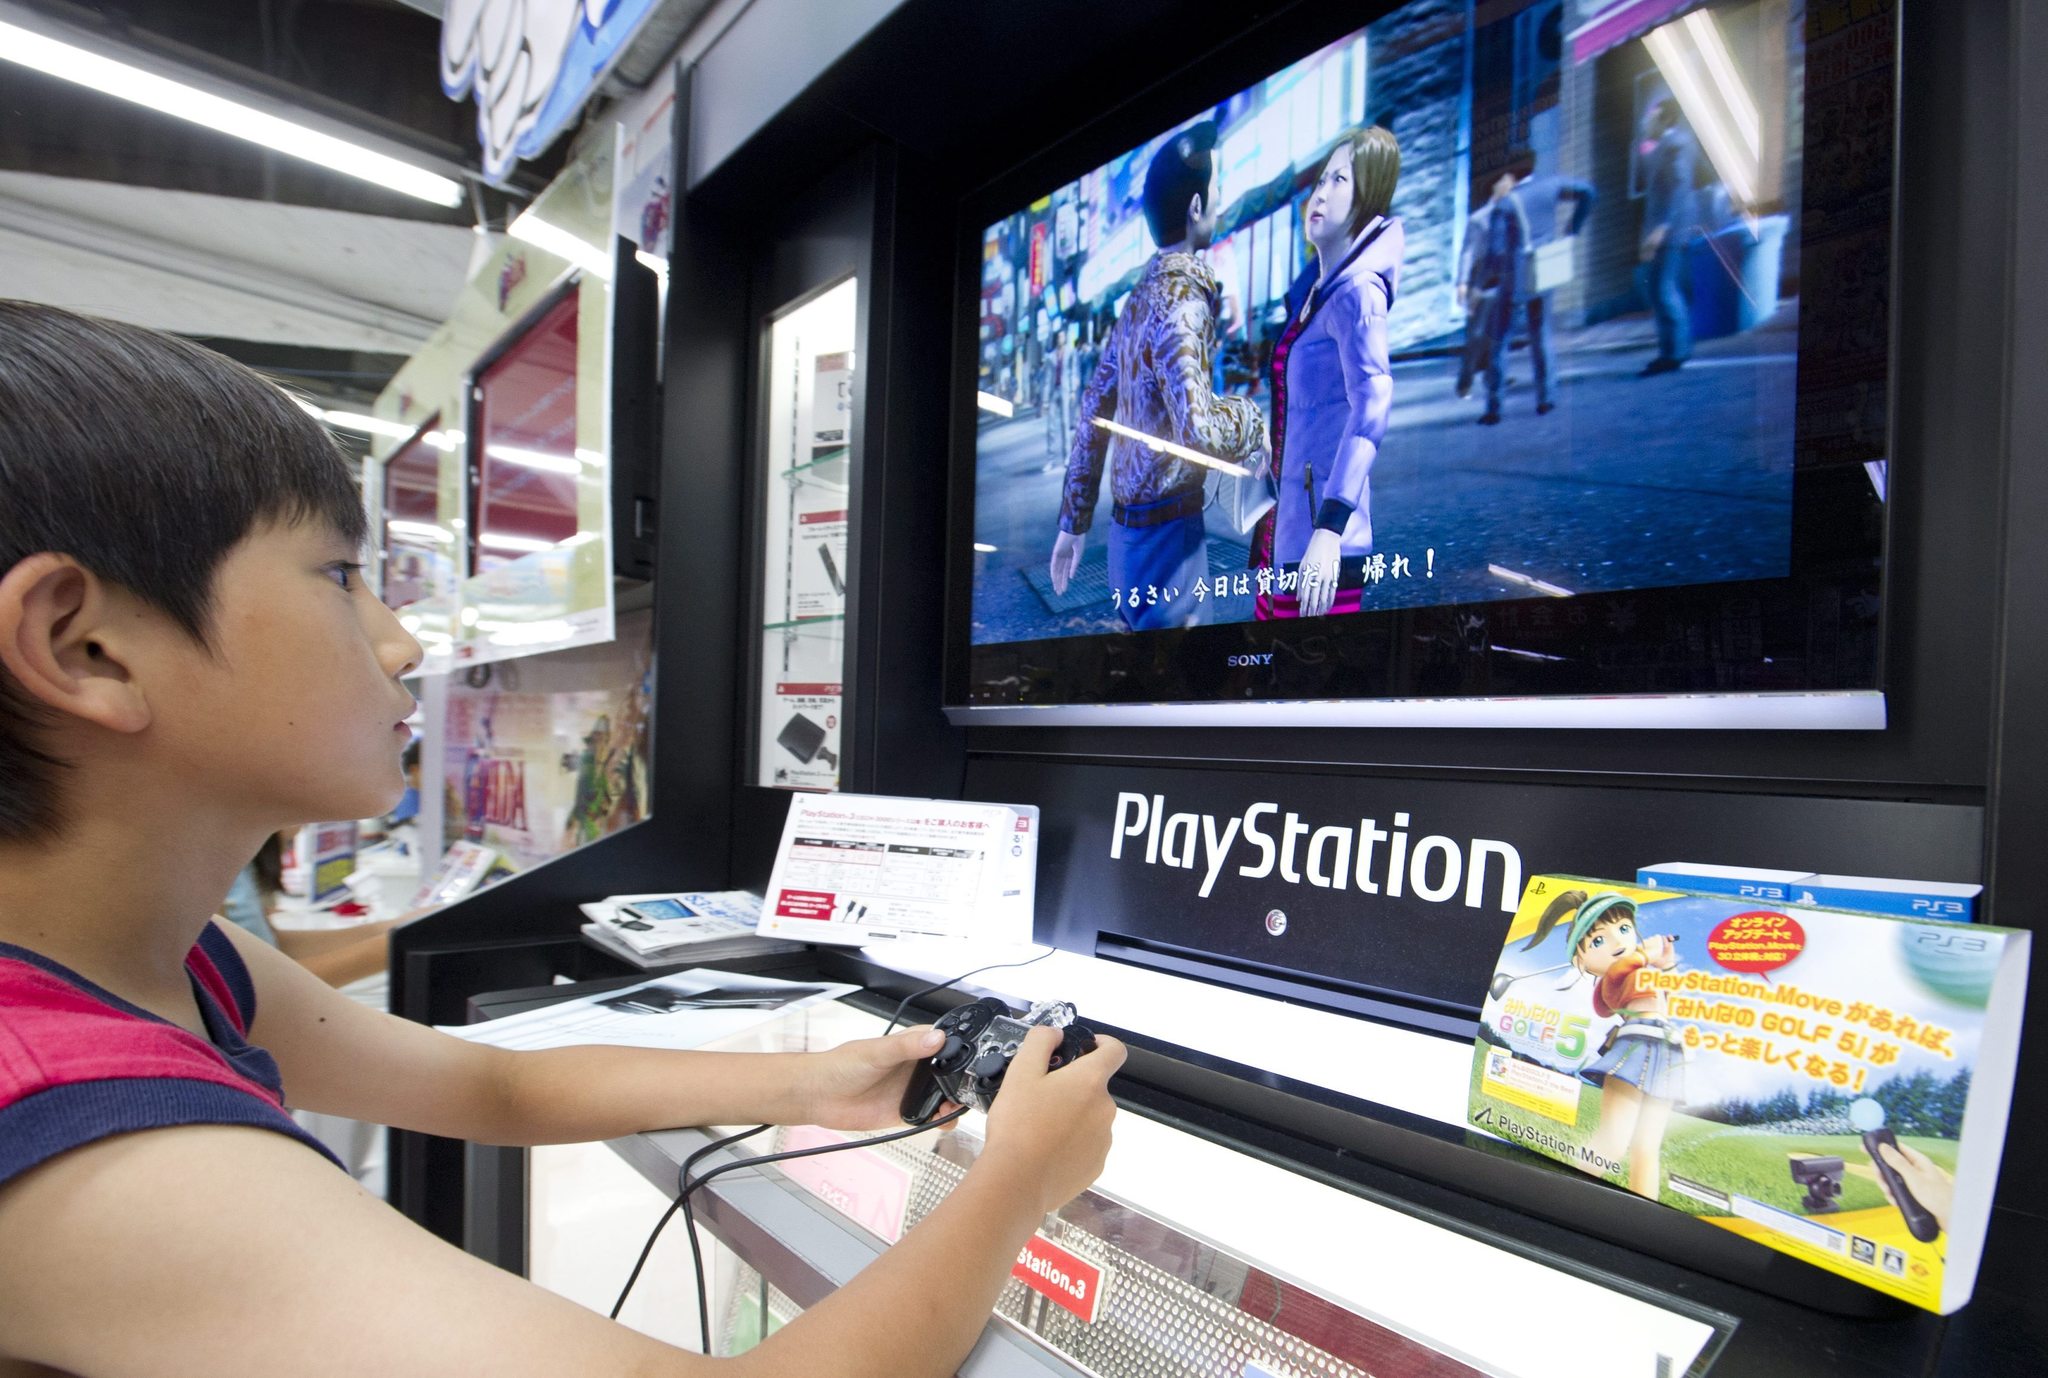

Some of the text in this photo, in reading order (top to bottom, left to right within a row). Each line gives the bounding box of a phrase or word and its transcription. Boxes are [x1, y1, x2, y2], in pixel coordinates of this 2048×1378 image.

[1111, 584, 1180, 610] うるさい
[1228, 653, 1273, 667] SONY
[1110, 792, 1522, 913] PlayStation
[1740, 885, 1785, 899] PS3
[1912, 899, 1966, 914] PS3
[1730, 917, 1788, 928] オンライン
[1918, 931, 1988, 952] PS3
[1504, 997, 1560, 1026] みんなの
[1500, 1014, 1556, 1043] GOLF
[1555, 1012, 1590, 1060] 5
[1761, 1012, 1833, 1043] GOLF
[1499, 1115, 1621, 1174] PlayStation Move
